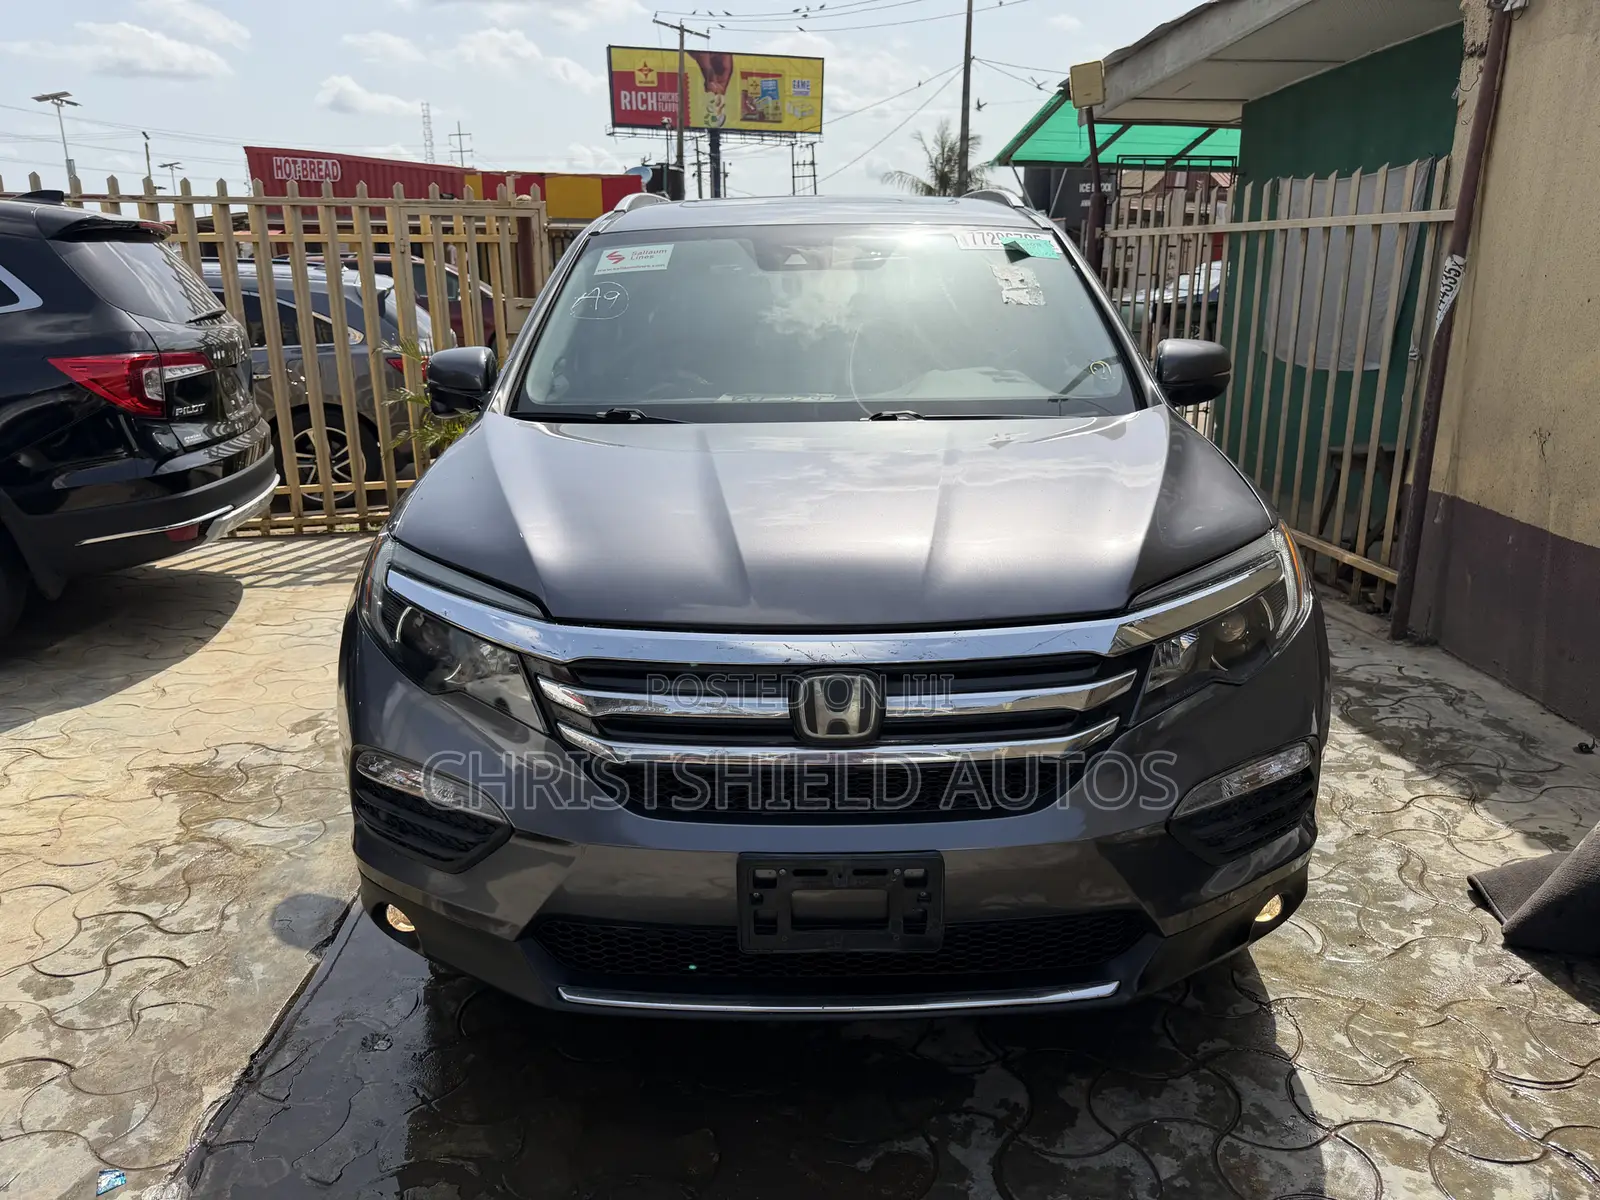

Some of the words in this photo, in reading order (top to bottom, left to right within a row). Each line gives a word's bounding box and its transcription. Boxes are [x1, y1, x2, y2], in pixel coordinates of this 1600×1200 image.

[620, 90, 658, 111] RICH
[658, 91, 679, 102] CHICKE
[273, 157, 299, 180] HOT
[300, 158, 342, 182] BREAD
[175, 403, 206, 416] PILOT
